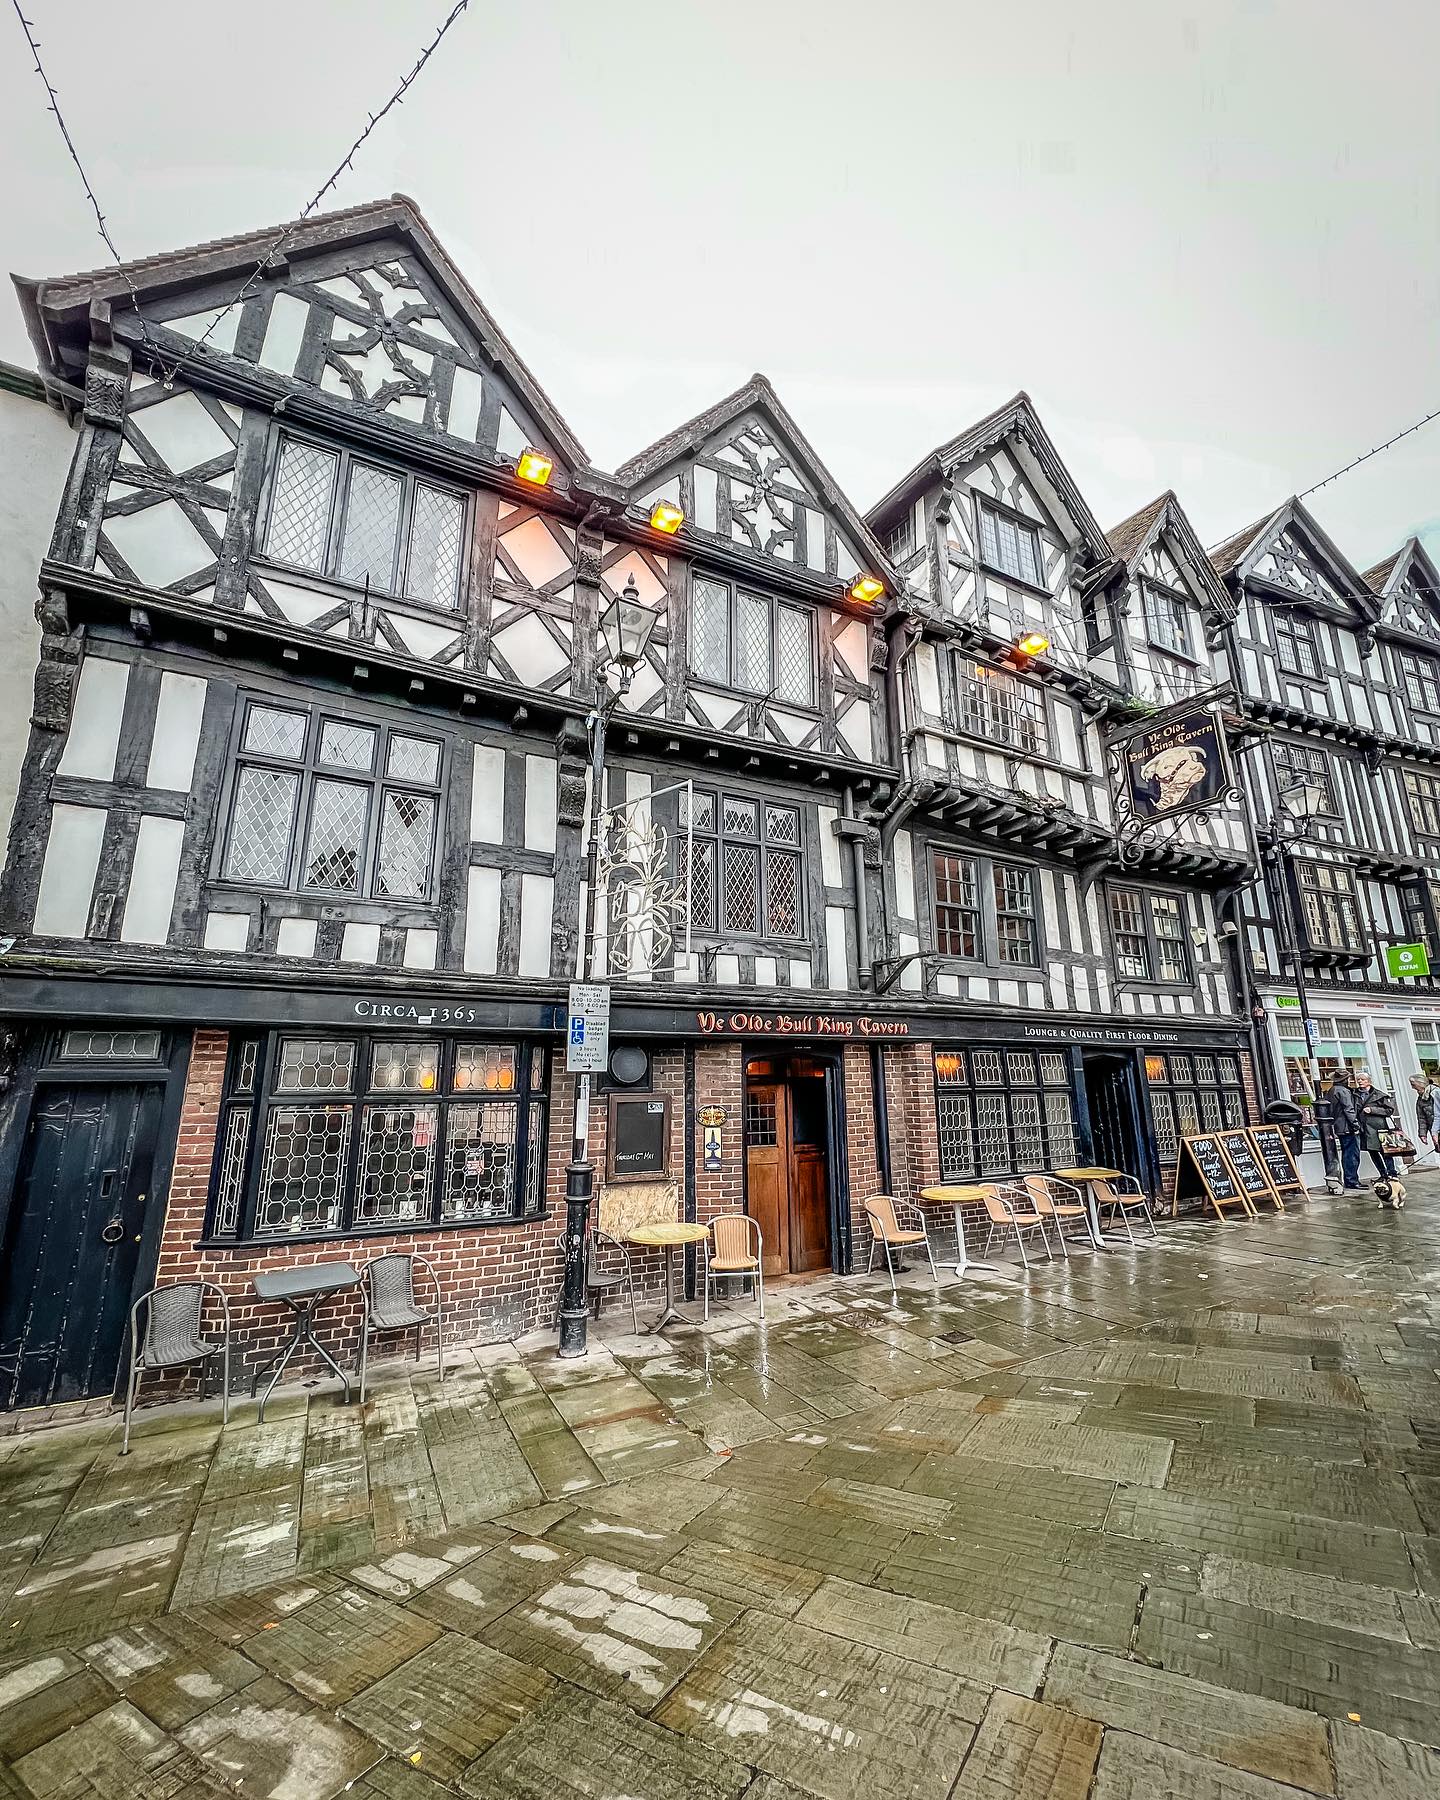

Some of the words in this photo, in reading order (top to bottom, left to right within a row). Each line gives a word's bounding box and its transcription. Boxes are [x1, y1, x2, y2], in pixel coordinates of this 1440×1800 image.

[1148, 733, 1161, 744] Ye
[1163, 723, 1186, 737] Olde
[1128, 747, 1149, 763] Bull
[1175, 724, 1213, 744] Tavern
[1398, 963, 1419, 971] OXFAM
[429, 1005, 476, 1023] 1365
[574, 1019, 583, 1030] P
[697, 1011, 725, 1033] Ye
[728, 1013, 773, 1032] Olde
[776, 1014, 813, 1033] Bull
[815, 1015, 853, 1036] Ring
[856, 1016, 909, 1036] Tavern
[1193, 1140, 1212, 1152] FOOD
